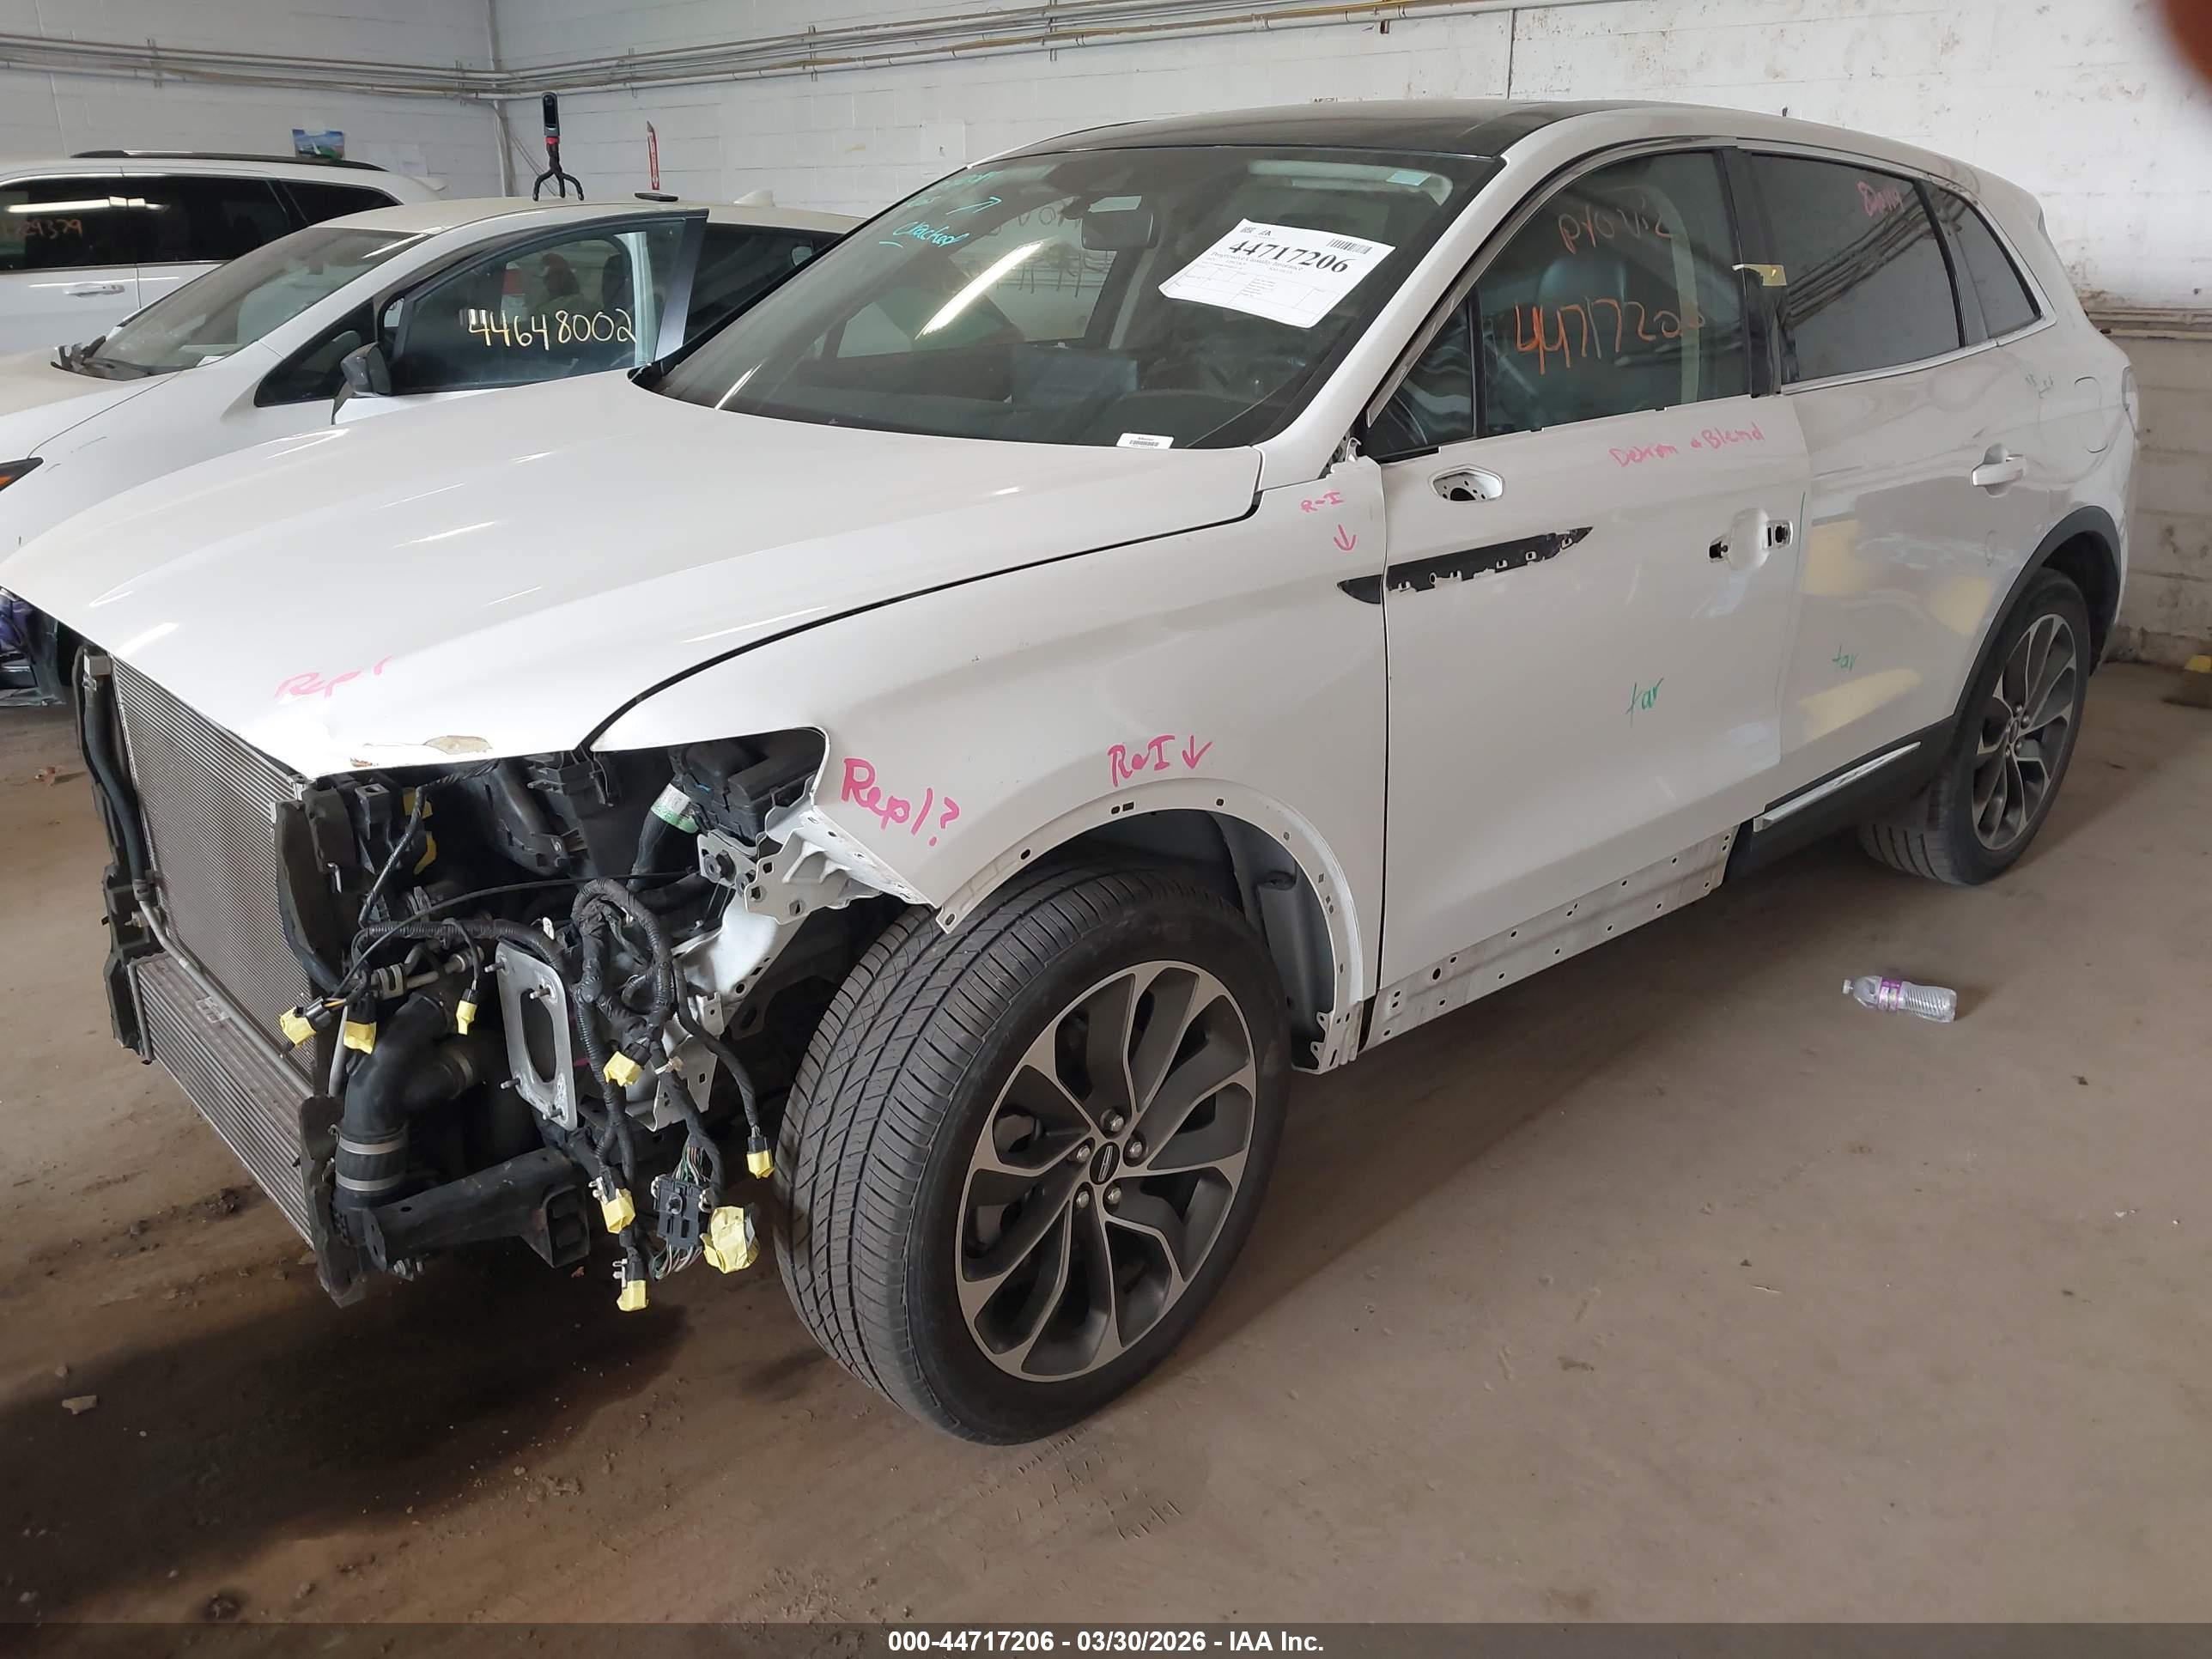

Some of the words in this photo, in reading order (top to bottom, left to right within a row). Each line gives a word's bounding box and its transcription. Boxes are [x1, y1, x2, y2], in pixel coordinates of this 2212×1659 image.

[1228, 240, 1357, 273] 44717206
[468, 307, 637, 350] 44648002
[1701, 421, 1765, 449] Blend
